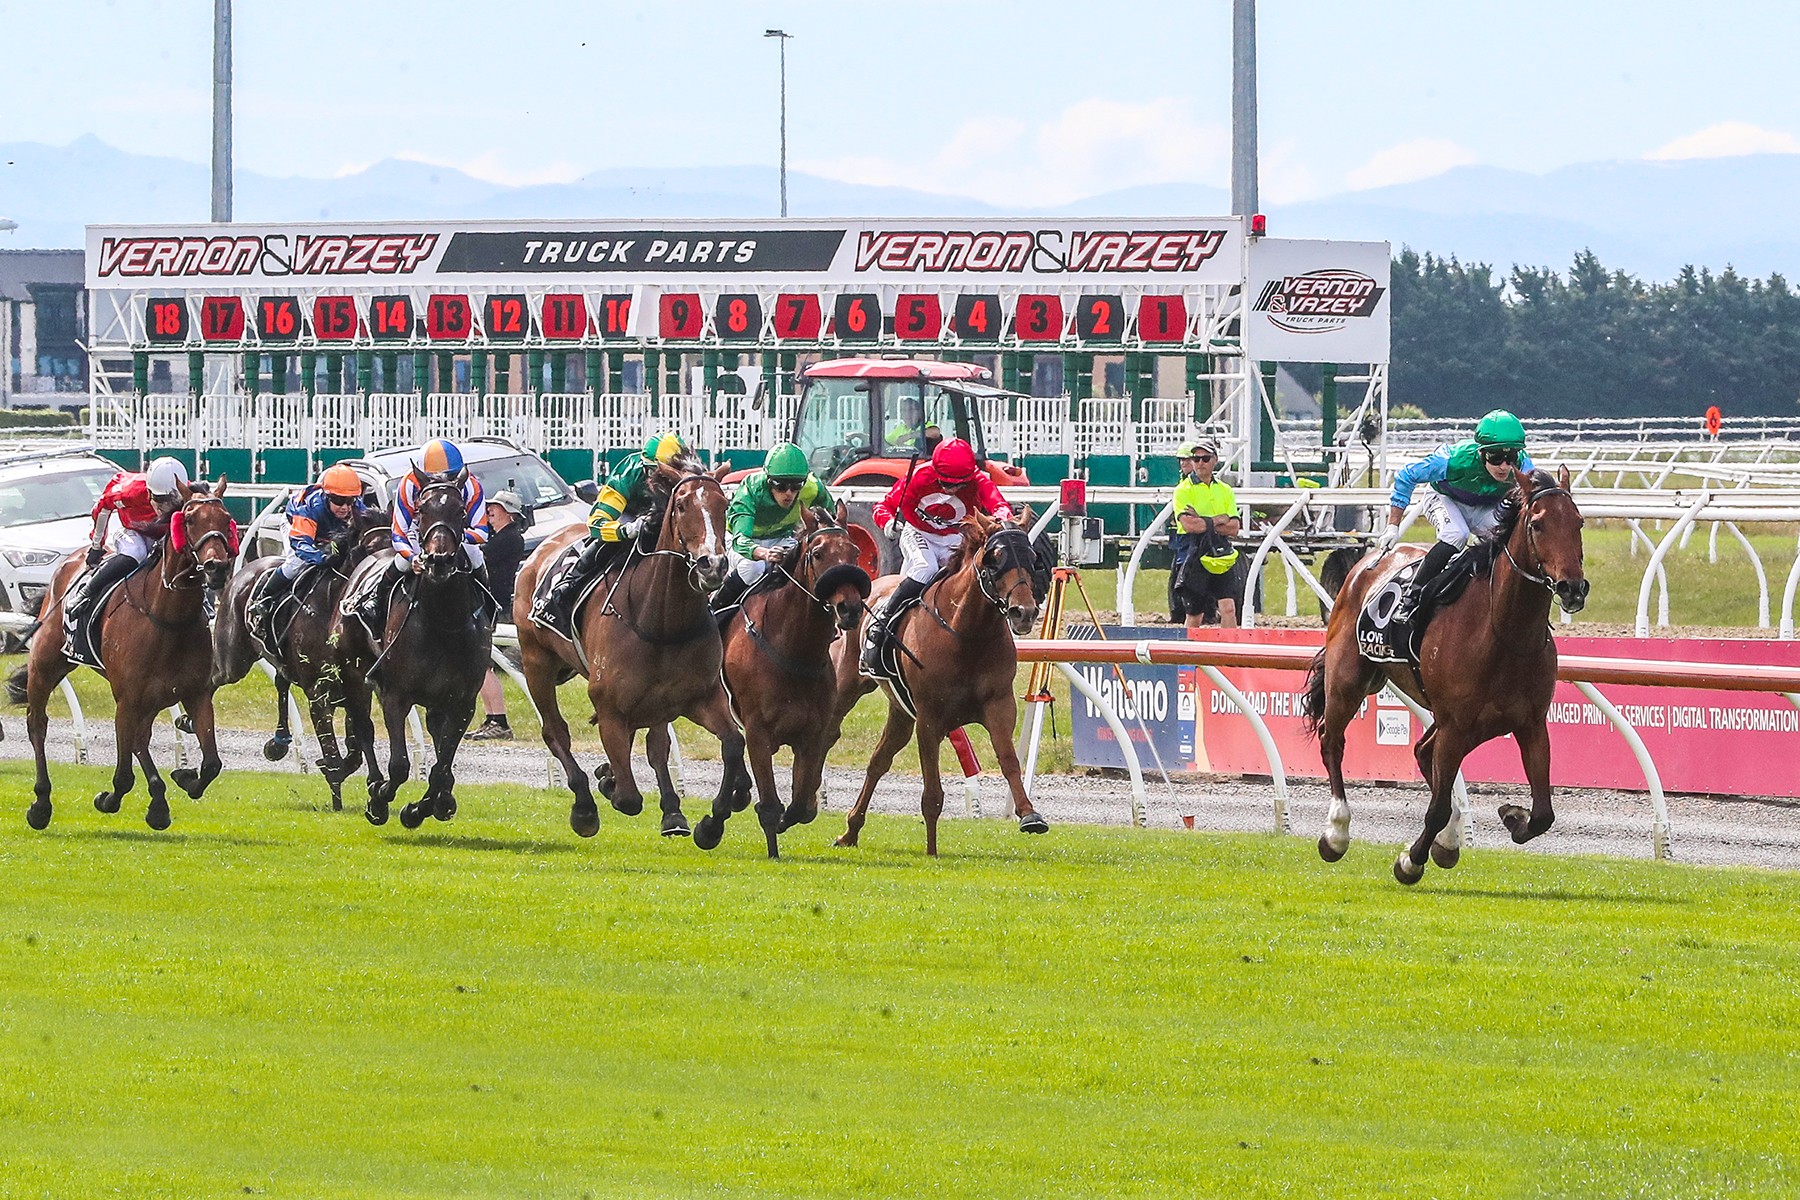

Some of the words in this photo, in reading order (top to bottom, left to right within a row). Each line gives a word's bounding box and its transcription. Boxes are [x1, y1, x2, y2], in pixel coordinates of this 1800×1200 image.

[523, 240, 635, 264] TRUCK
[645, 240, 757, 263] PARTS
[1283, 277, 1376, 296] VERNON
[154, 304, 180, 335] 18
[209, 303, 236, 334] 17
[263, 302, 295, 334] 16
[320, 302, 349, 333] 15
[376, 301, 406, 333] 14
[434, 300, 464, 332] 13
[490, 300, 522, 332] 12
[552, 300, 575, 331] 11
[672, 300, 688, 331] 9
[728, 300, 747, 332] 8
[788, 300, 805, 332] 7
[848, 299, 866, 332] 6
[908, 300, 926, 332] 5
[968, 300, 987, 333] 4
[1030, 300, 1048, 333] 3
[1091, 300, 1110, 334] 2
[1157, 301, 1167, 334] 1
[1285, 316, 1314, 324] TRUCK
[1360, 630, 1384, 645] LOVE
[1270, 692, 1290, 716] THE
[1625, 705, 1665, 728] SERVICES
[1673, 706, 1707, 729] DIGITAL
[1709, 707, 1799, 732] TRANSFORMATION
